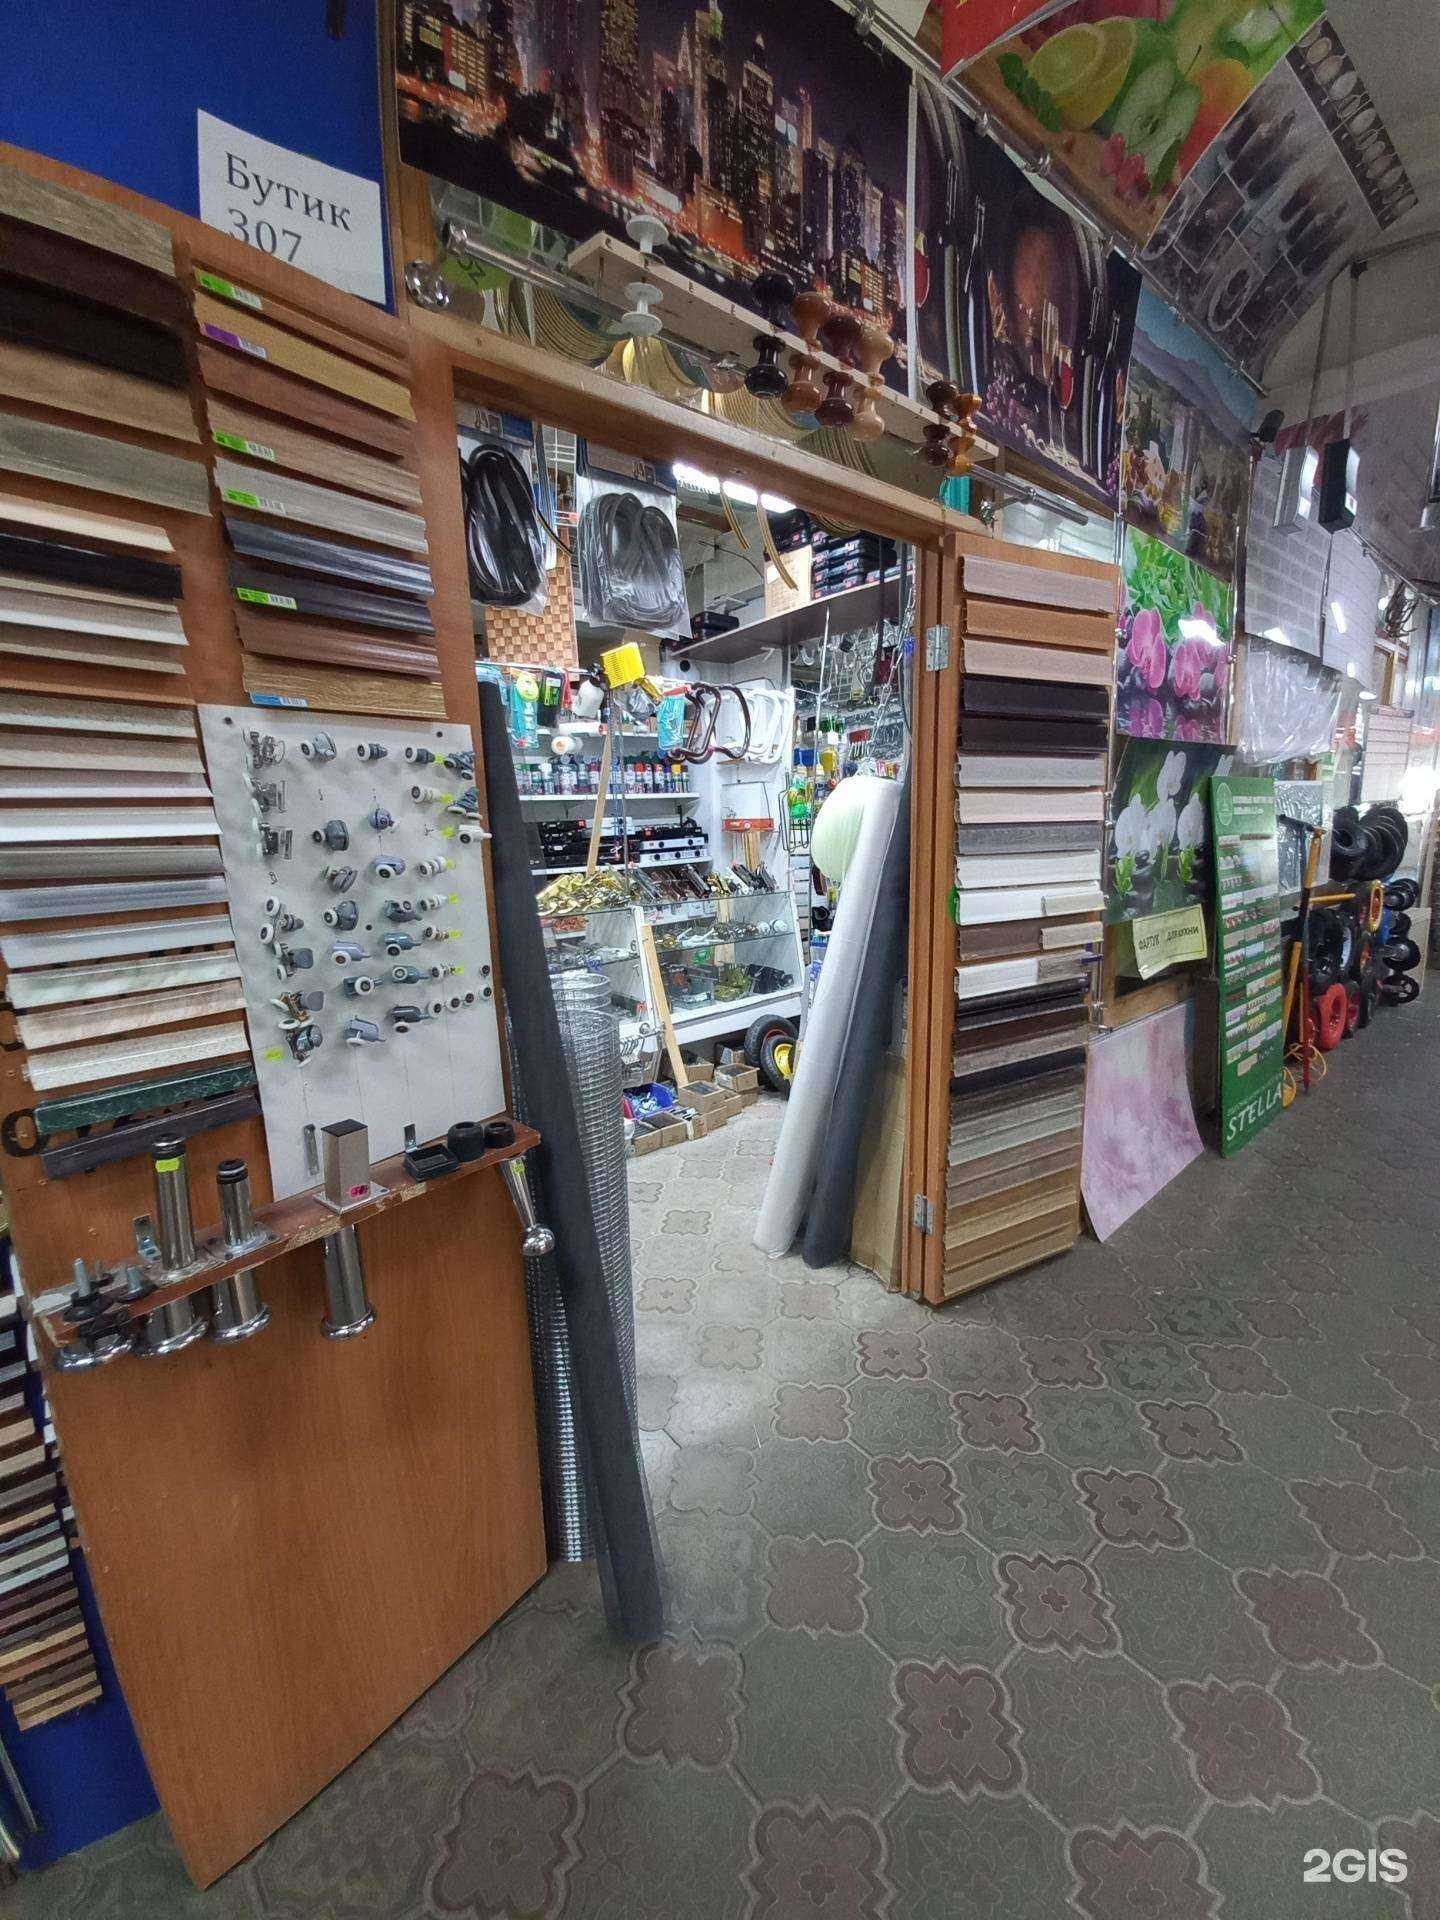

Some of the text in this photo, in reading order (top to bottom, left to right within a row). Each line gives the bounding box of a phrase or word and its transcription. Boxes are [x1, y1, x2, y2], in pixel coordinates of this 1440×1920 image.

[224, 150, 352, 233] Бутик
[228, 207, 303, 263] 307
[1226, 1081, 1282, 1142] STELLA
